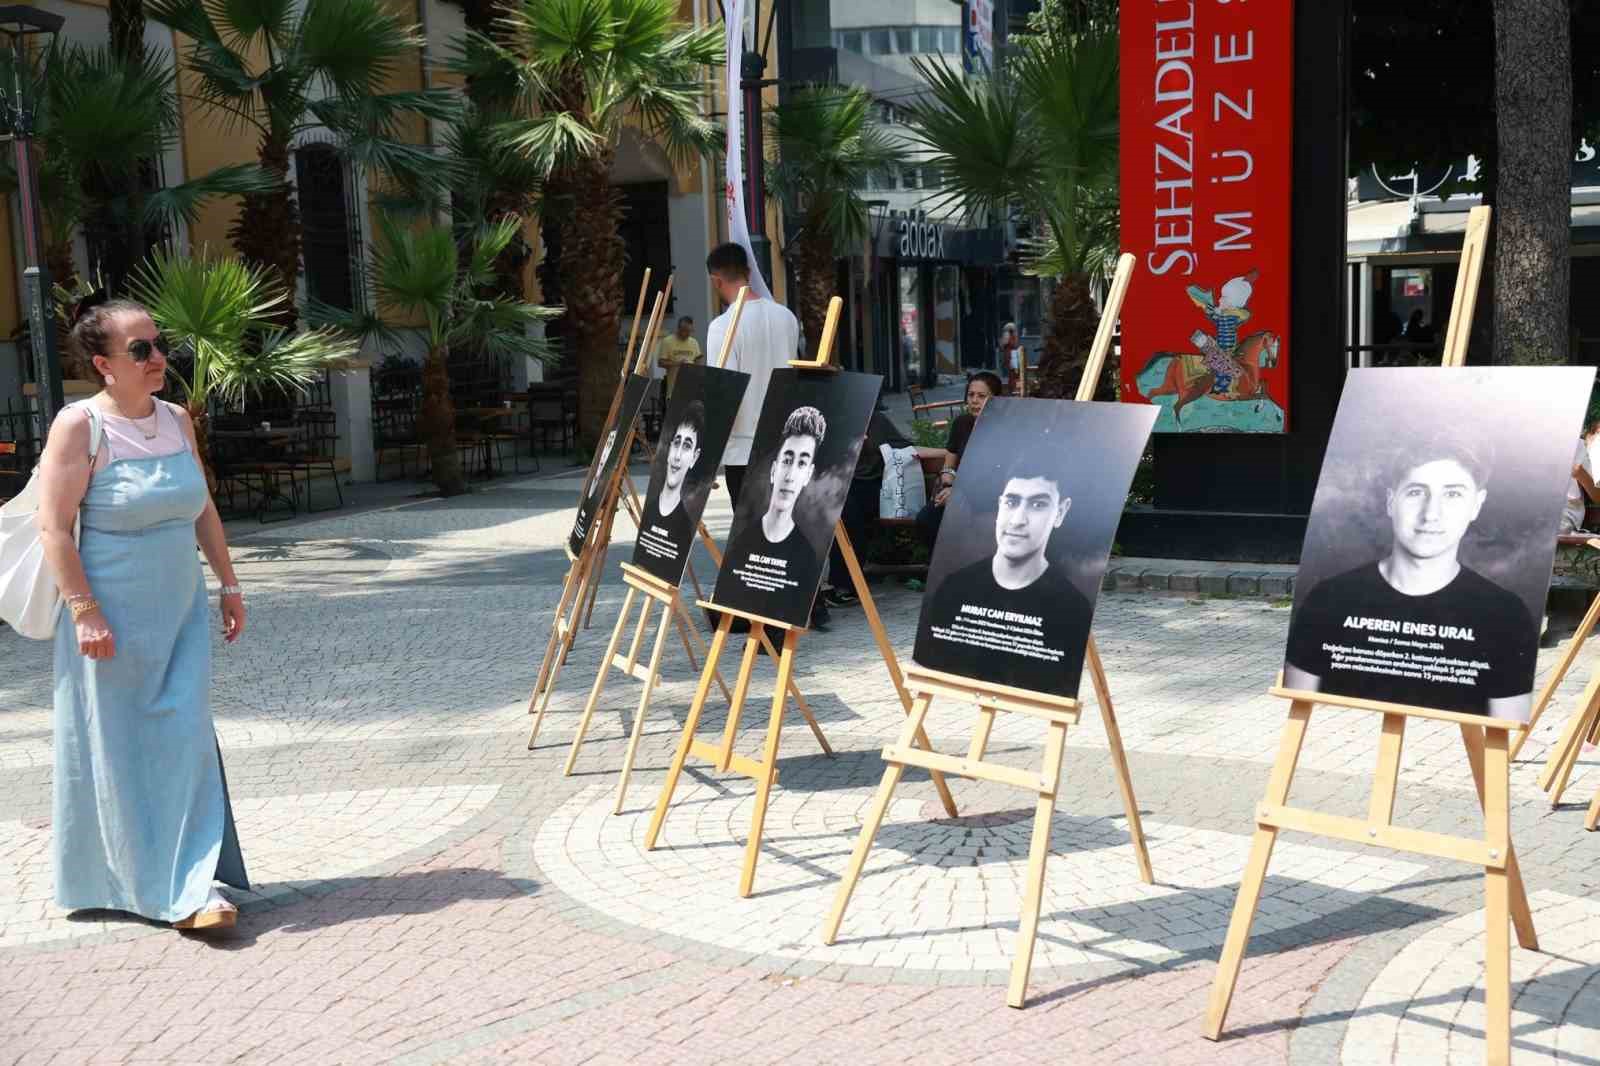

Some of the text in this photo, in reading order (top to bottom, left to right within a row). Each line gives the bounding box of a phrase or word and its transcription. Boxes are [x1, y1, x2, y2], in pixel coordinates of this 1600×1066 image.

[1147, 0, 1198, 276] ŞEHZADEL
[1211, 0, 1254, 251] MÜZE
[900, 208, 945, 258] addax
[987, 608, 1005, 620] CAN
[1343, 615, 1476, 641] ALPEREN ENES URAL
